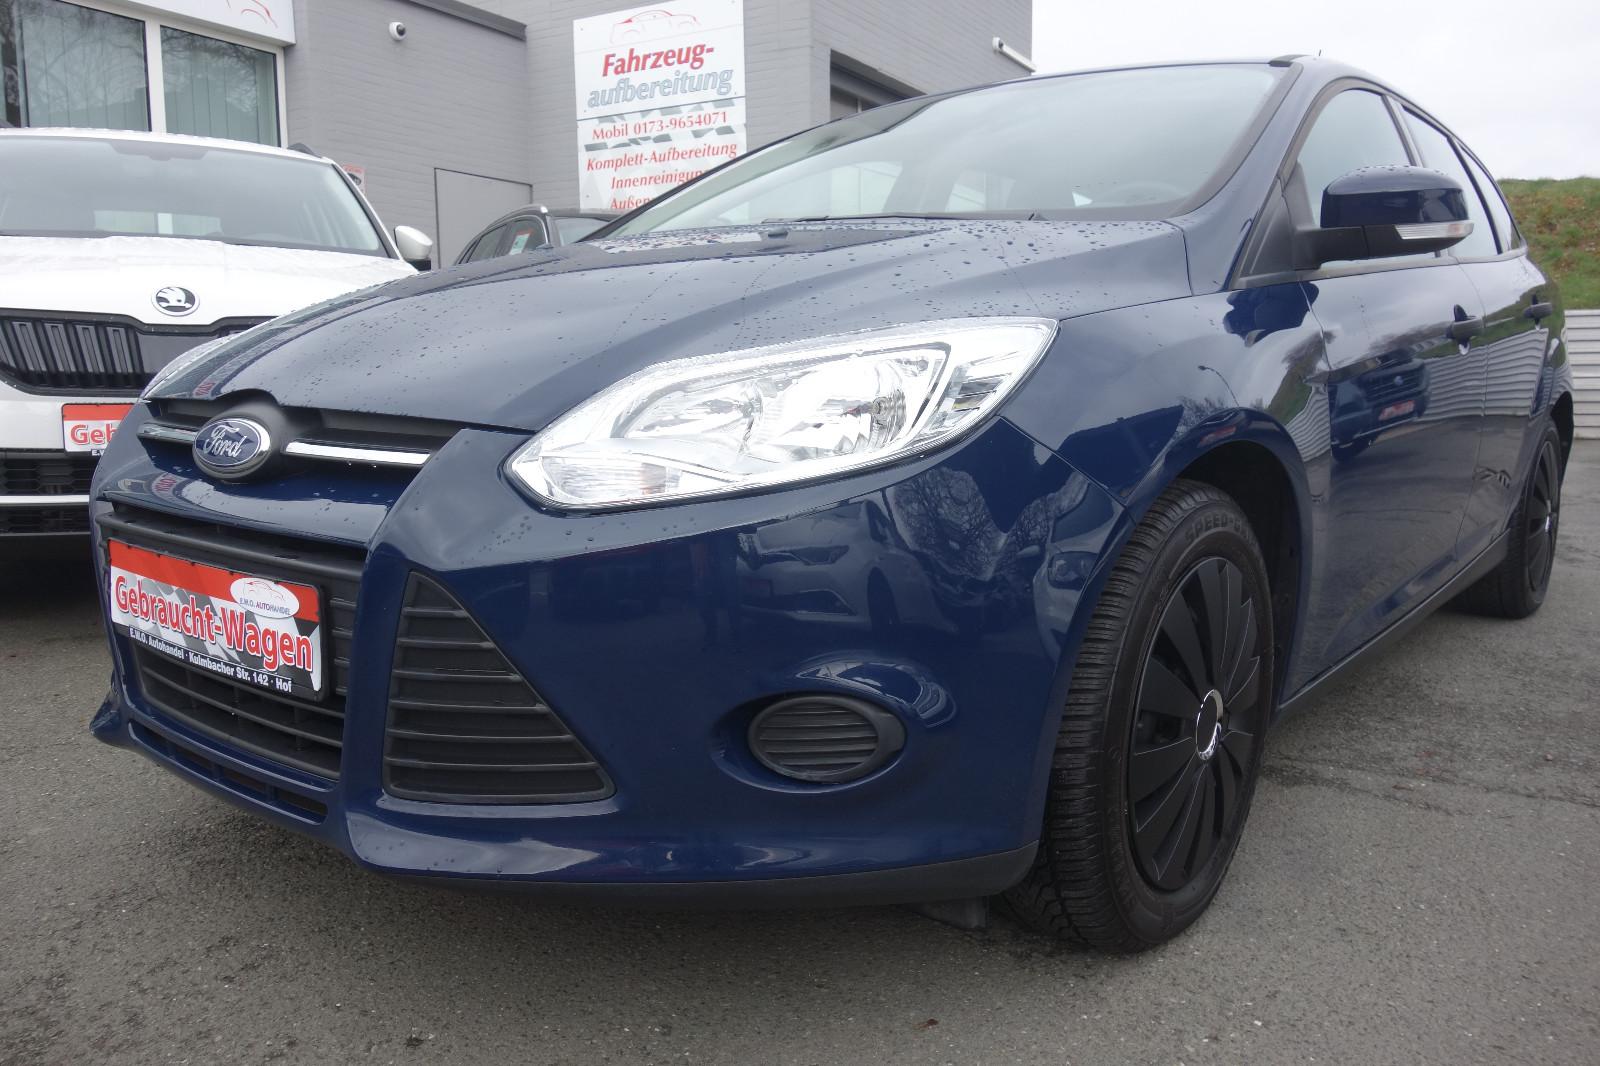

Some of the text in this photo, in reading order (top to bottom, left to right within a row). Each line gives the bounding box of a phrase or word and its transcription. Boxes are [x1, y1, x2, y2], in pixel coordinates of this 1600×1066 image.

[602, 43, 714, 76] Fahrzeug-
[588, 69, 734, 108] aufbereitung
[592, 111, 727, 140] Mobil 0173-9654071
[587, 143, 737, 172] Komplett-Aufbereitung
[203, 425, 247, 457] Ford
[115, 575, 314, 672] Gebraucht-Wagen
[148, 636, 185, 660] Autohandel
[188, 651, 235, 676] Kulmbacher
[236, 667, 251, 681] Str.
[252, 672, 269, 686] 142
[275, 678, 292, 693] Hof
